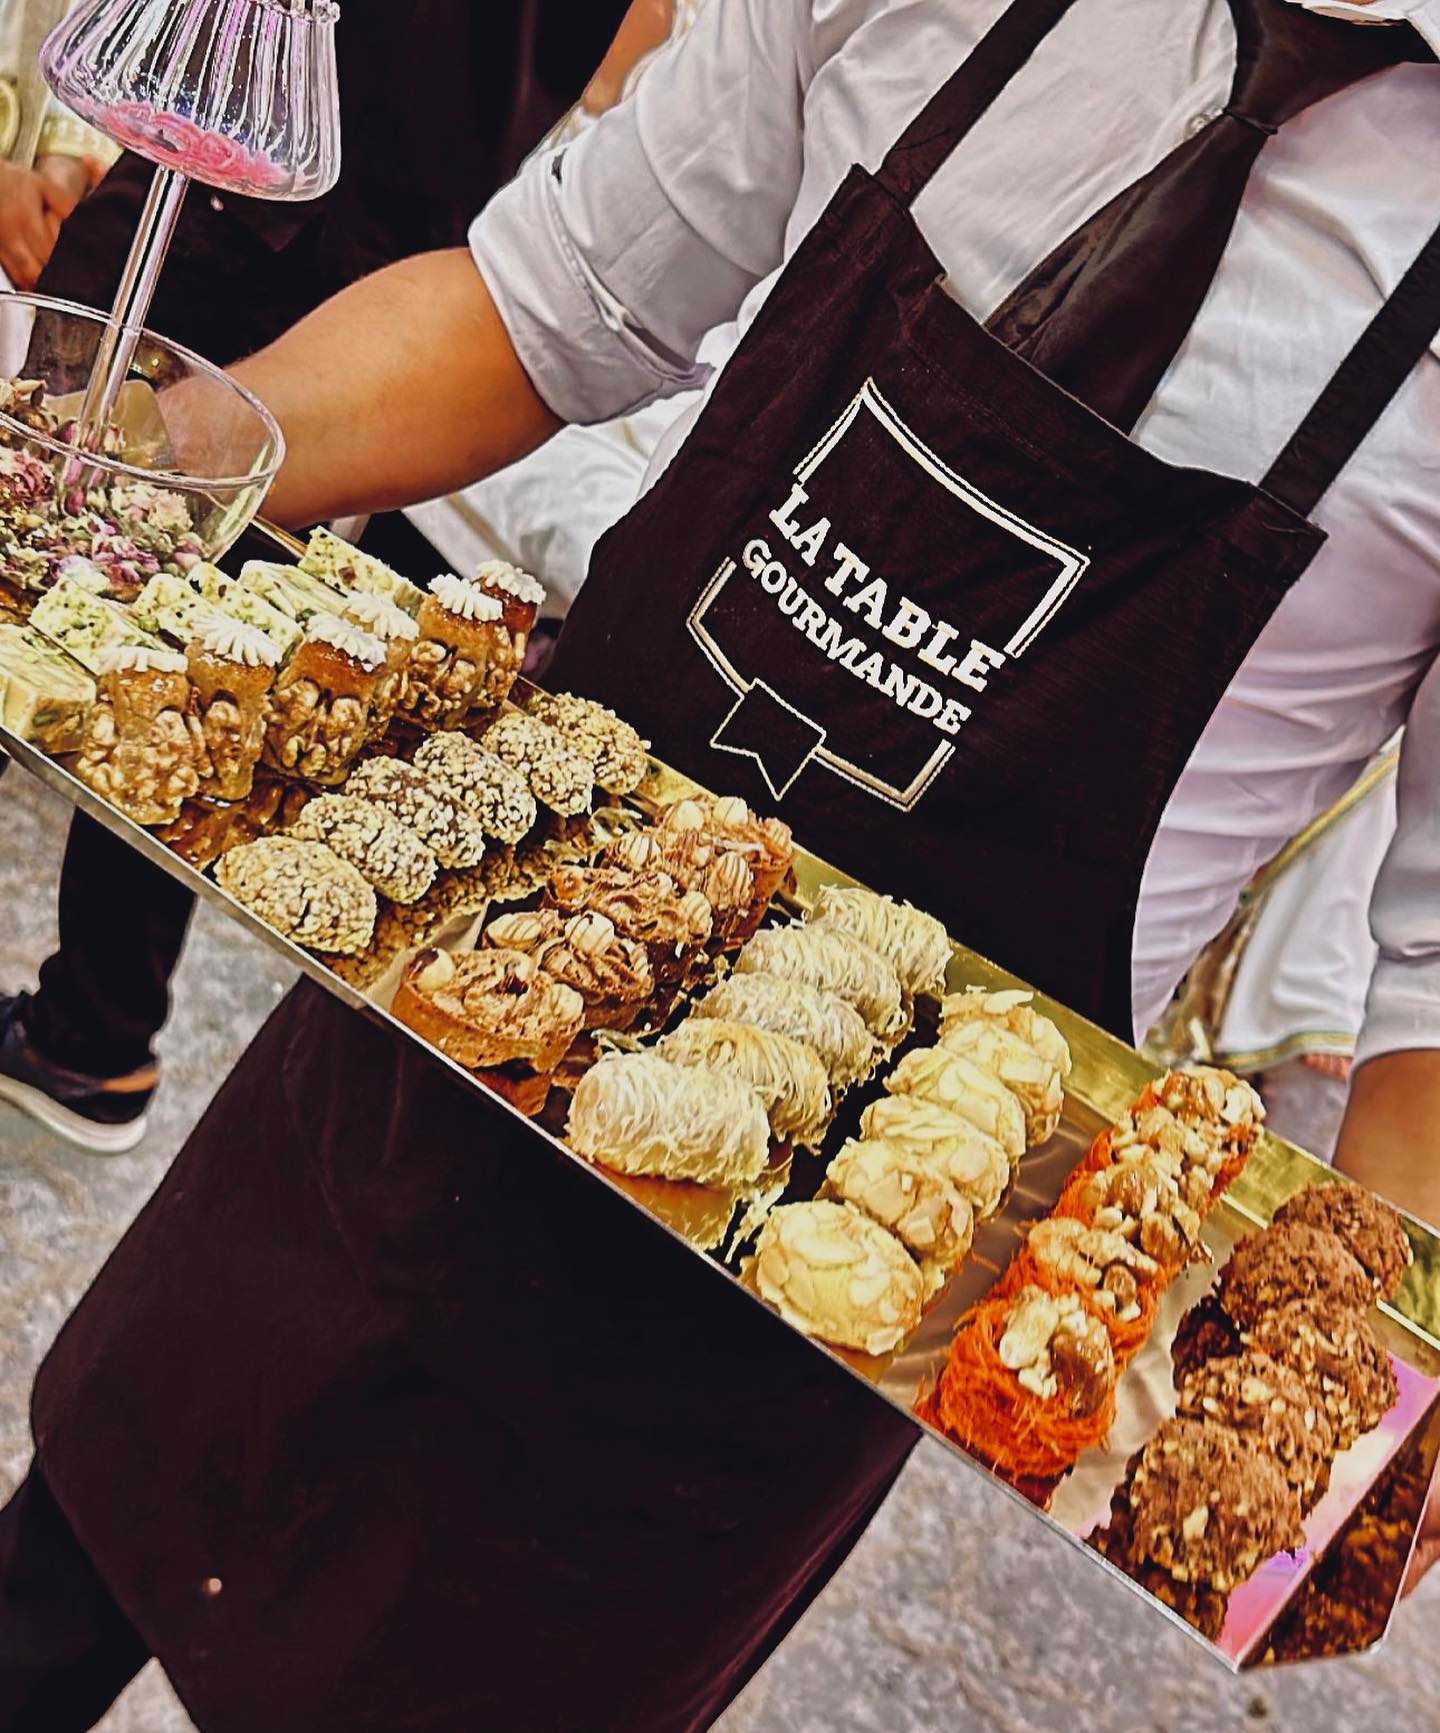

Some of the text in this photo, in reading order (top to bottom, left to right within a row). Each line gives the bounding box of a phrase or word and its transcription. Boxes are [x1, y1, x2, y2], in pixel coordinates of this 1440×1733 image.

[742, 539, 972, 735] GOURMANDE
[768, 483, 1006, 692] LA TABLE
